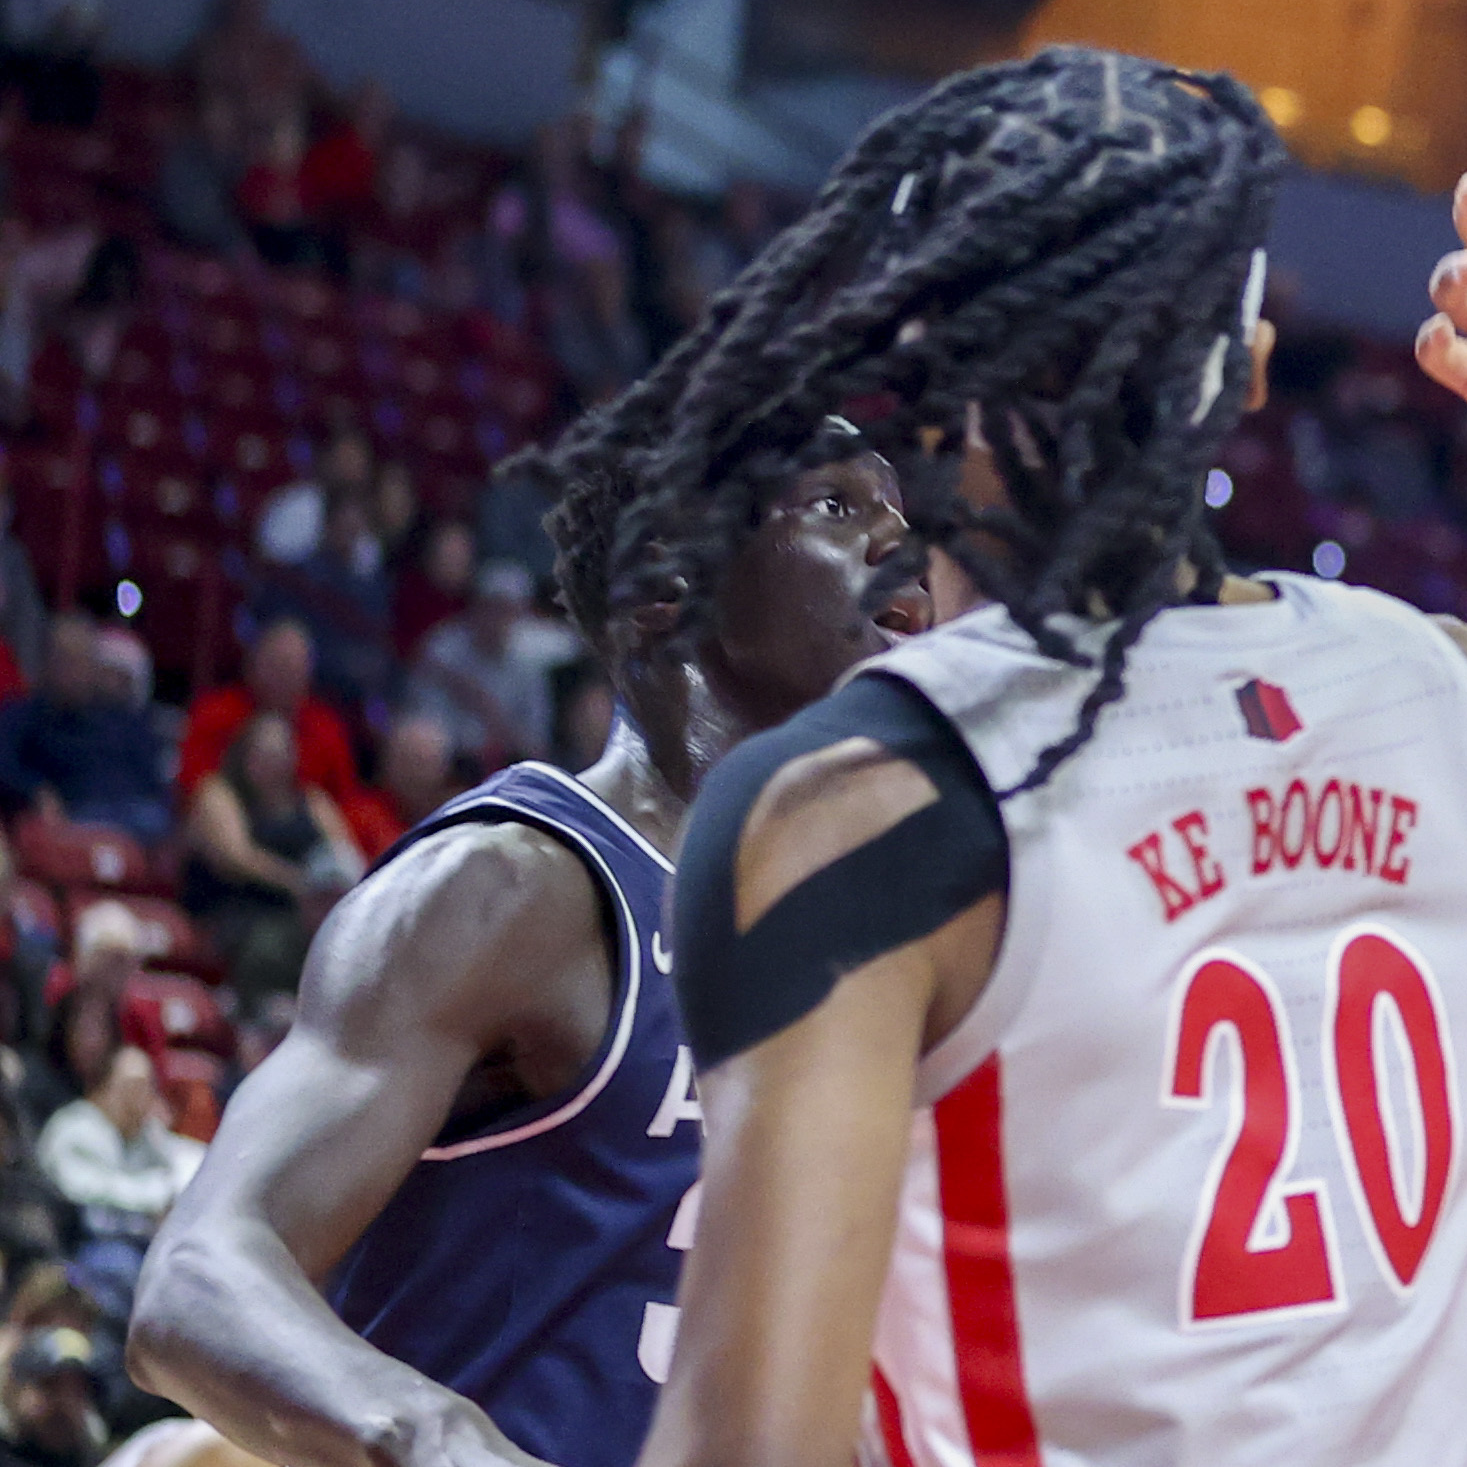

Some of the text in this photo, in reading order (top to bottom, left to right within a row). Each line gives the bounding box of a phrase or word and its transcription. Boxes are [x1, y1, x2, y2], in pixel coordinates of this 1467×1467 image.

[1127, 778, 1418, 923] KE BOONE
[1160, 922, 1463, 1331] 20
